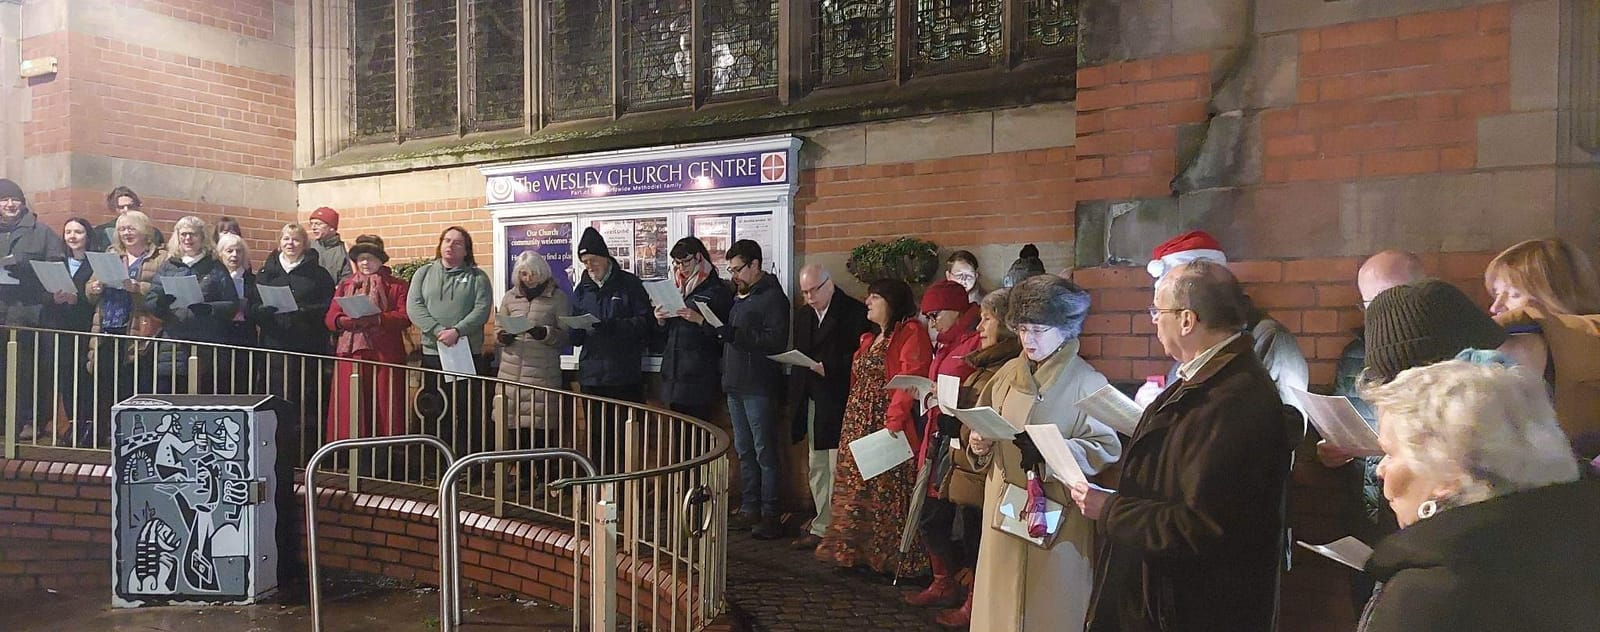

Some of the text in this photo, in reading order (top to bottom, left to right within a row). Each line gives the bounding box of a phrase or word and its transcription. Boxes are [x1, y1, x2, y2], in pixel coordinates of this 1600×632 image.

[515, 176, 541, 193] The
[543, 170, 603, 191] WESLEY
[607, 164, 682, 186] CHURCH
[688, 157, 757, 180] CENTRE
[664, 182, 682, 190] family
[526, 228, 559, 237] Our Church
[511, 238, 540, 247] community
[541, 237, 568, 246] welcomes
[546, 252, 558, 260] find
